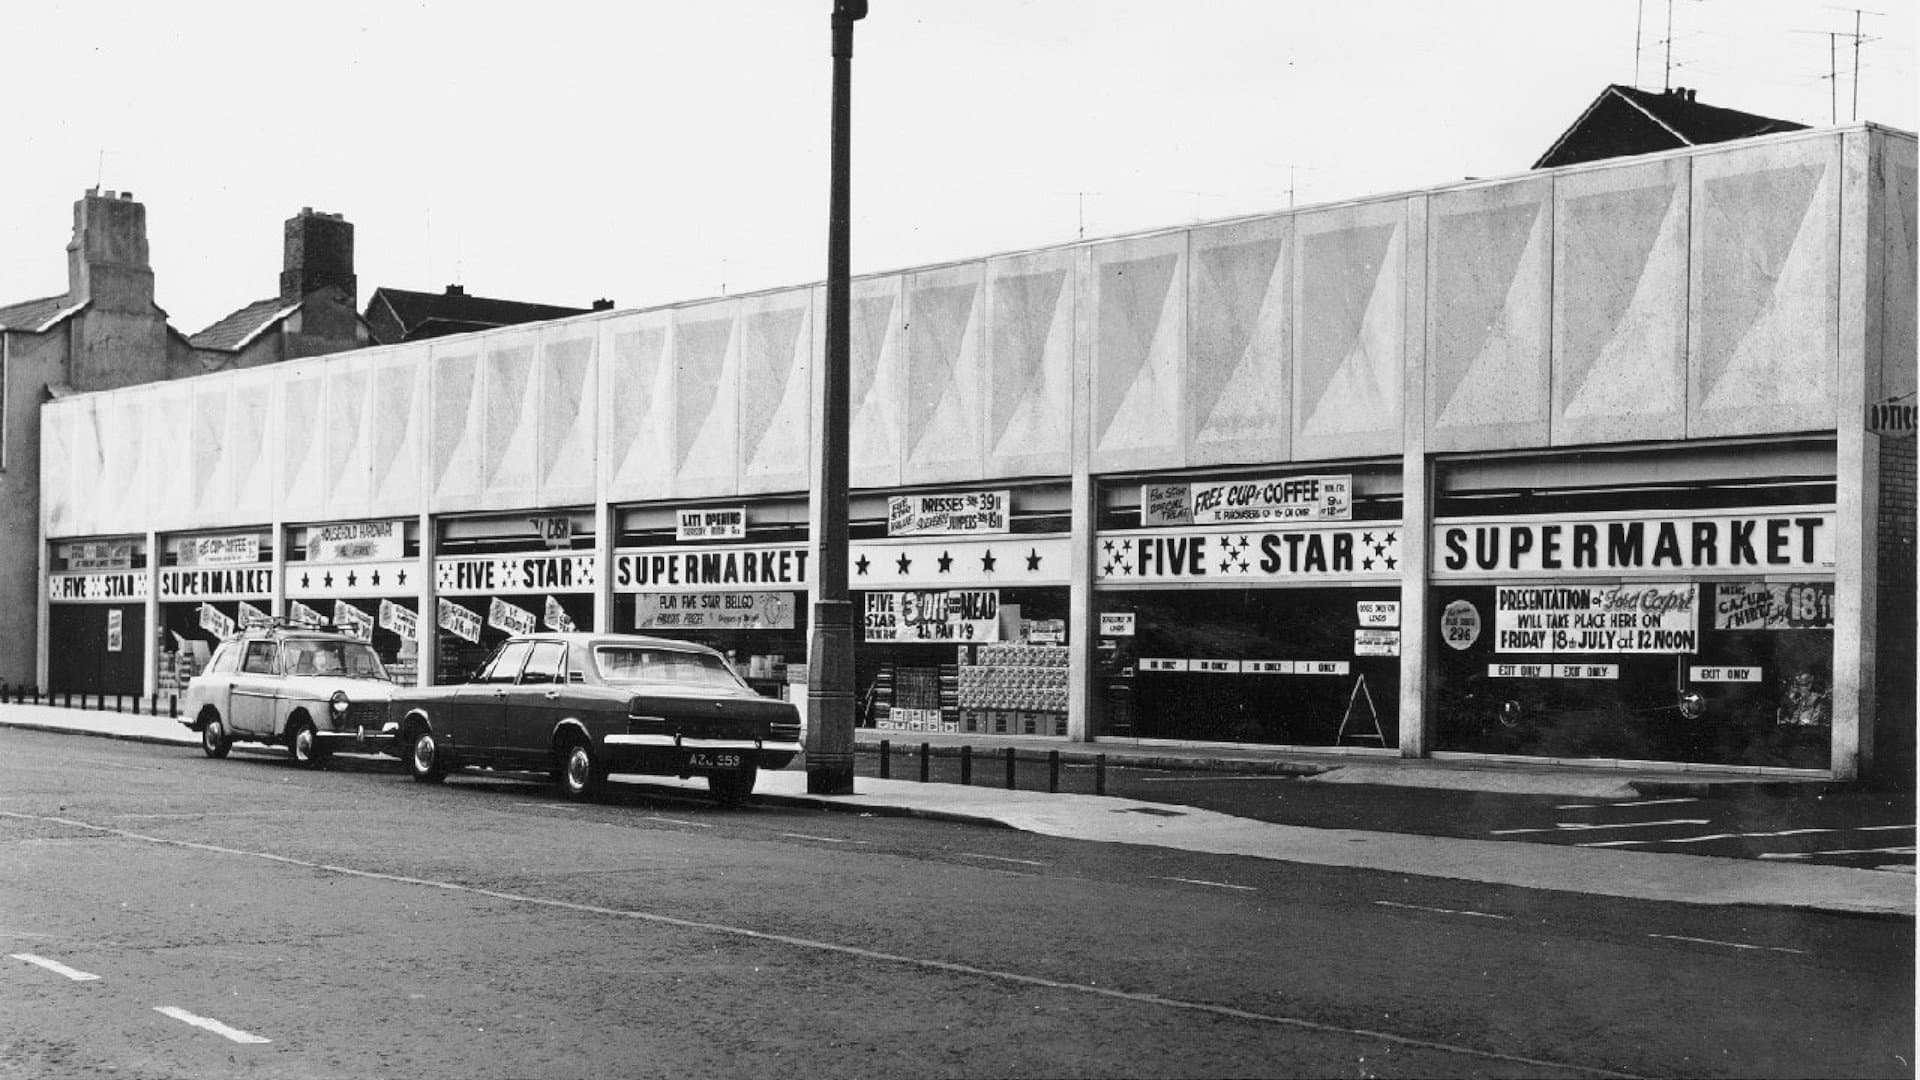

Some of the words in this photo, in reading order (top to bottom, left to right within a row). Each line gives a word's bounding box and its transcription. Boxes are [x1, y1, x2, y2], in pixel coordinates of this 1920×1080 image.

[922, 497, 964, 512] DRESSES
[1195, 486, 1224, 516] FREE
[1227, 484, 1255, 506] CUP
[1263, 480, 1319, 503] COFFEE
[1138, 537, 1206, 576] FIVE
[1260, 533, 1354, 573] STAR
[1445, 517, 1823, 571] SUPERMARKET
[458, 561, 495, 589] FIVE
[523, 559, 572, 588] STAR
[618, 550, 809, 586] SUPERMARKET
[64, 577, 86, 597] FIVE
[105, 575, 134, 597] STAR
[163, 569, 272, 596] SUPERMARKET
[660, 595, 676, 609] PLAY
[682, 595, 696, 609] FIVE
[701, 595, 720, 609] STAR
[867, 593, 894, 612] FIVE
[961, 591, 997, 620] BREAD
[1500, 589, 1591, 611] PRESENTATION
[1604, 585, 1640, 613] Ford
[1640, 588, 1694, 616] Capri
[865, 613, 896, 628] STAR
[1518, 614, 1542, 629] WILL
[1547, 613, 1570, 629] TAKE
[1574, 613, 1605, 629] PLACE
[1611, 613, 1637, 628] HERE
[1642, 613, 1661, 628] ON
[1501, 630, 1546, 649] FRIDAY
[1578, 630, 1616, 649] JULY
[1617, 630, 1633, 649] at
[1638, 630, 1651, 649] 12
[1654, 630, 1695, 649] NOON
[1499, 665, 1515, 676] EXIT
[1521, 665, 1541, 676] ONLY
[1564, 666, 1581, 677] EXIT
[1587, 666, 1609, 677] ONLY
[1701, 668, 1720, 680] EXIT
[1728, 669, 1749, 680] ONLY
